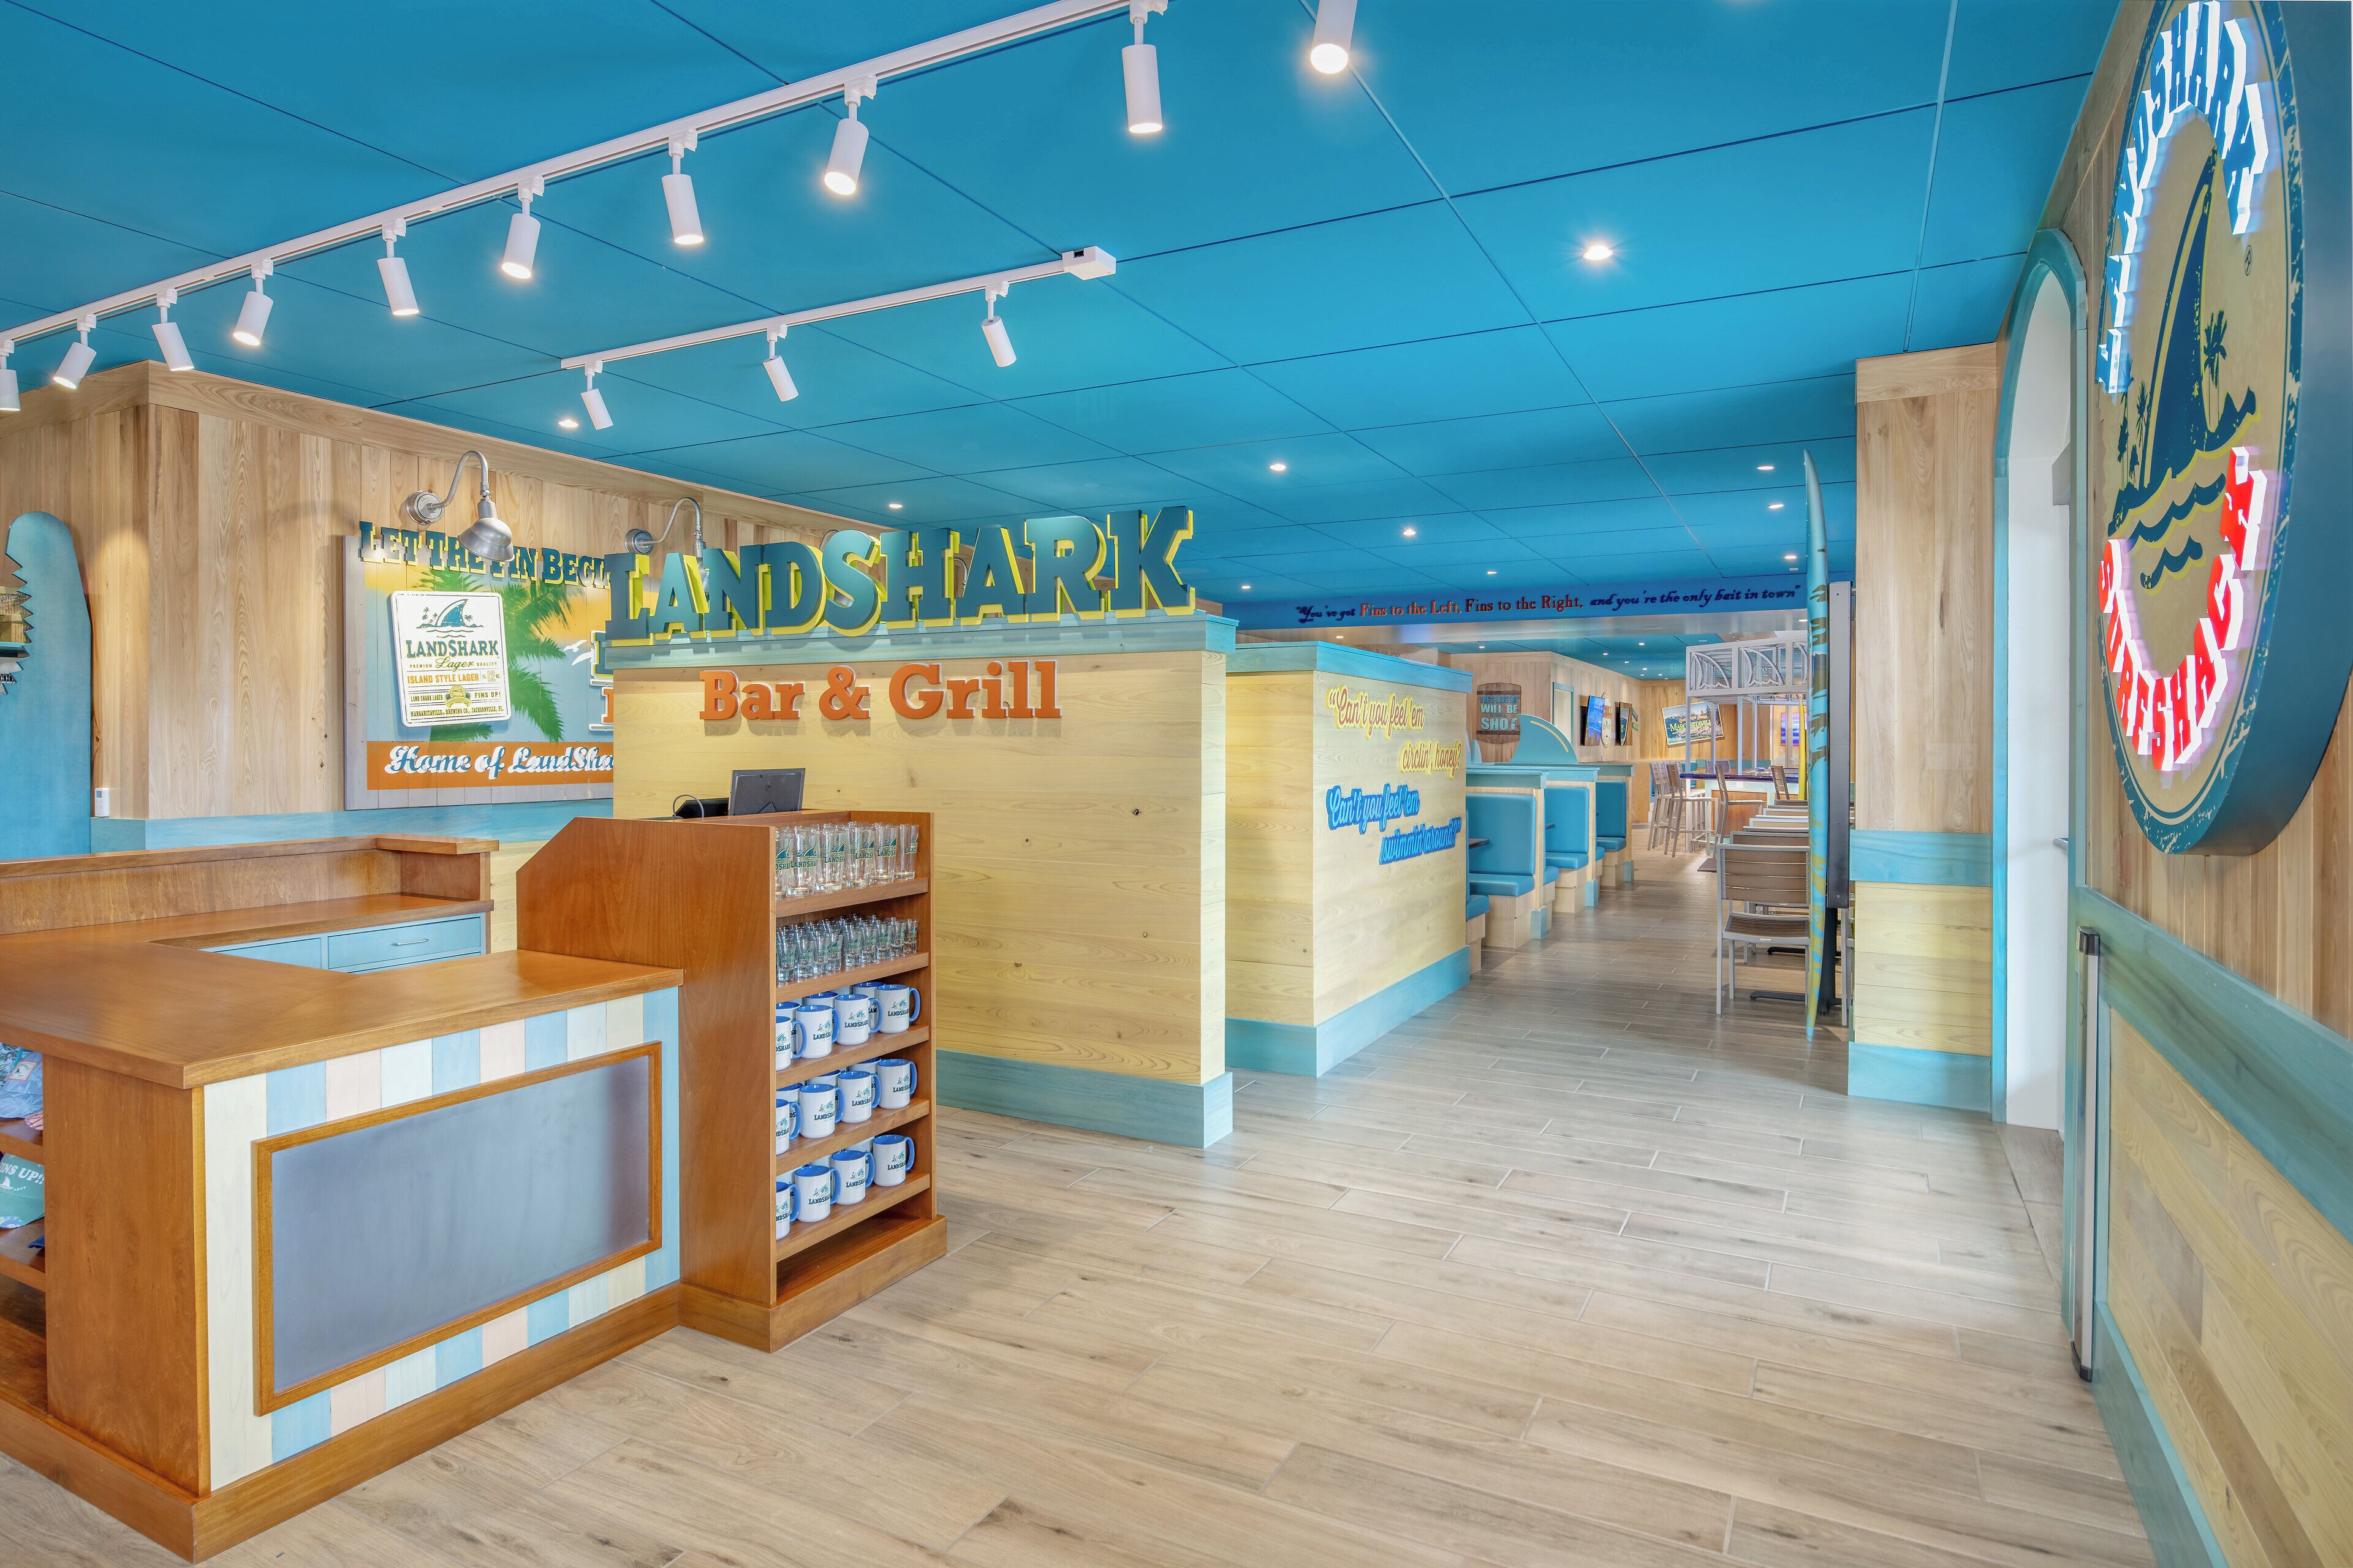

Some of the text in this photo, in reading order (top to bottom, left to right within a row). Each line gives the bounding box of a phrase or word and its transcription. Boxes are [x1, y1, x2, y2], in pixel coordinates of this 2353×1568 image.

[2095, 1, 2268, 393] LANDSHARK
[358, 520, 422, 566] LET
[604, 505, 1195, 646] LANDSHARK
[1336, 608, 1356, 621] got
[1361, 603, 1387, 617] Fins
[1391, 605, 1404, 615] to
[1408, 601, 1427, 615] the
[1431, 599, 1462, 614] Left,
[1466, 598, 1493, 612] Fins
[1498, 600, 1512, 611] to
[1516, 596, 1537, 610] the
[1541, 594, 1583, 612] Right,
[1590, 594, 1617, 605] and
[1660, 590, 1680, 603] the
[1683, 588, 1712, 608] only
[1715, 589, 1741, 601] bait
[1745, 588, 1758, 599] in
[405, 639, 499, 658] LANDSHARK
[435, 656, 474, 672] Lager
[407, 673, 479, 684] ISLAND STYLE LAGER
[699, 659, 1062, 721] Bar & Grill
[1368, 702, 1389, 737] you
[1388, 695, 1409, 737] feel
[1480, 704, 1518, 714] WILL BE
[1480, 717, 1518, 730] SHOT
[384, 745, 472, 774] Home
[474, 745, 506, 780] of
[1362, 797, 1383, 833] you
[1382, 786, 1403, 830] feel
